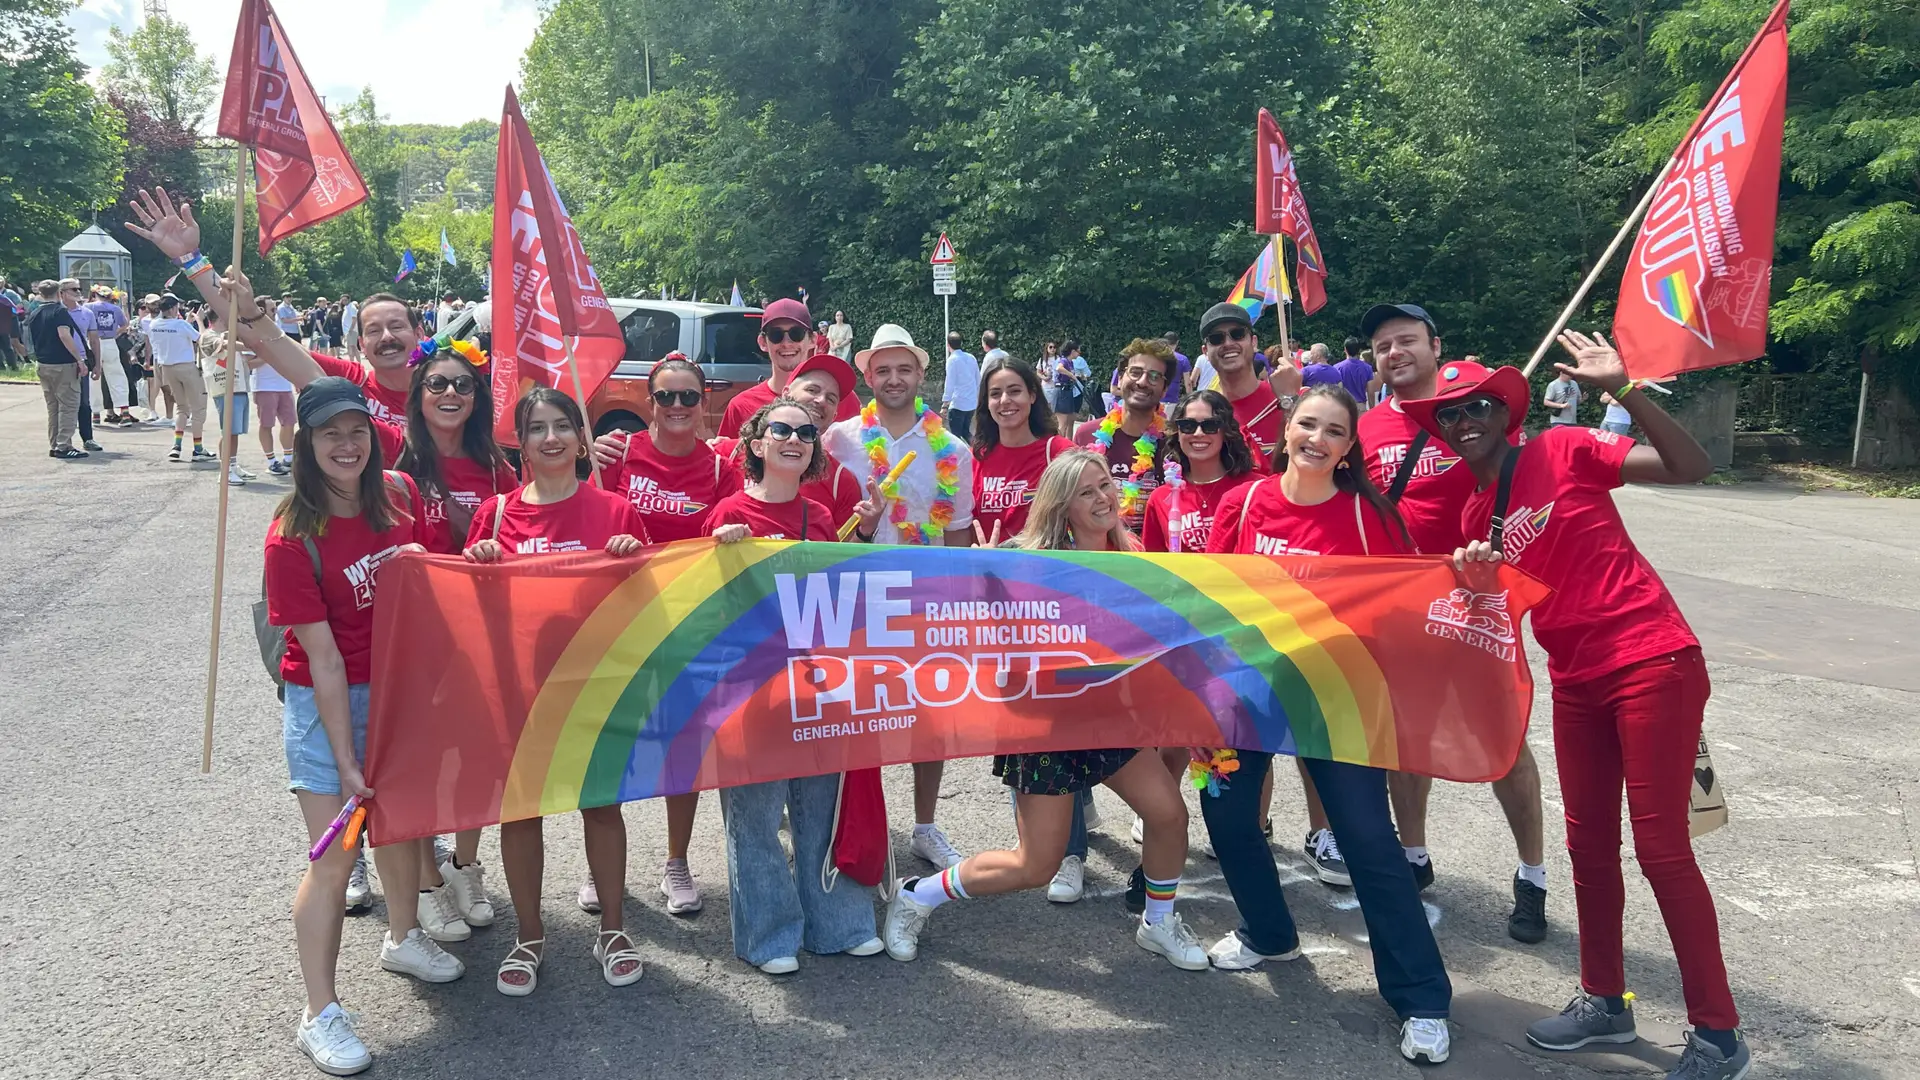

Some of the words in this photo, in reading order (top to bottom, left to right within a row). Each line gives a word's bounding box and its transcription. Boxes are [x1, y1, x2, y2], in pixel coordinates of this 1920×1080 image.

[1693, 174, 1709, 205] OUR
[1708, 161, 1744, 255] RAINBOWING
[1696, 205, 1728, 277] INCLUSION
[1378, 444, 1407, 465] WE
[629, 474, 658, 495] WE
[981, 487, 1040, 509] PROUD
[983, 476, 1006, 492] WE
[626, 489, 709, 517] PROUD
[1255, 532, 1289, 556] WE
[1502, 500, 1556, 562] ROUD
[516, 537, 550, 554] WE
[774, 570, 916, 649] WE
[925, 600, 1061, 622] RAINBOWING
[925, 625, 969, 647] OUR
[975, 624, 1087, 645] INCLUSION
[1425, 622, 1516, 663] GENERALI
[787, 648, 1174, 723] PROUD
[793, 720, 864, 743] GENERALI
[868, 714, 917, 733] GROUP
